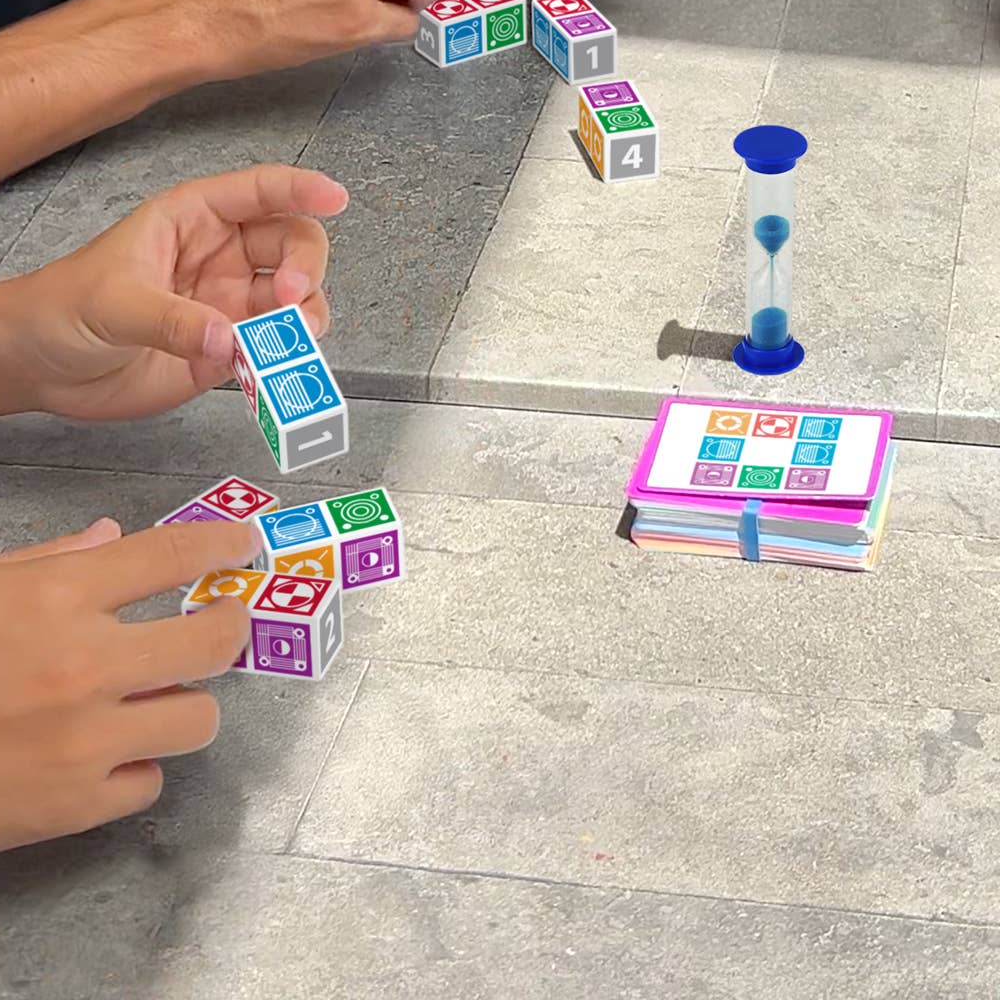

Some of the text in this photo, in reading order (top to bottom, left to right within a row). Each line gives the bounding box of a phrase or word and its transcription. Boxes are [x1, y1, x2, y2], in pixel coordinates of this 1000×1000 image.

[420, 28, 435, 49] 3
[586, 46, 599, 70] 1
[621, 143, 643, 169] 4
[297, 429, 333, 451] 1
[324, 611, 336, 652] 2
